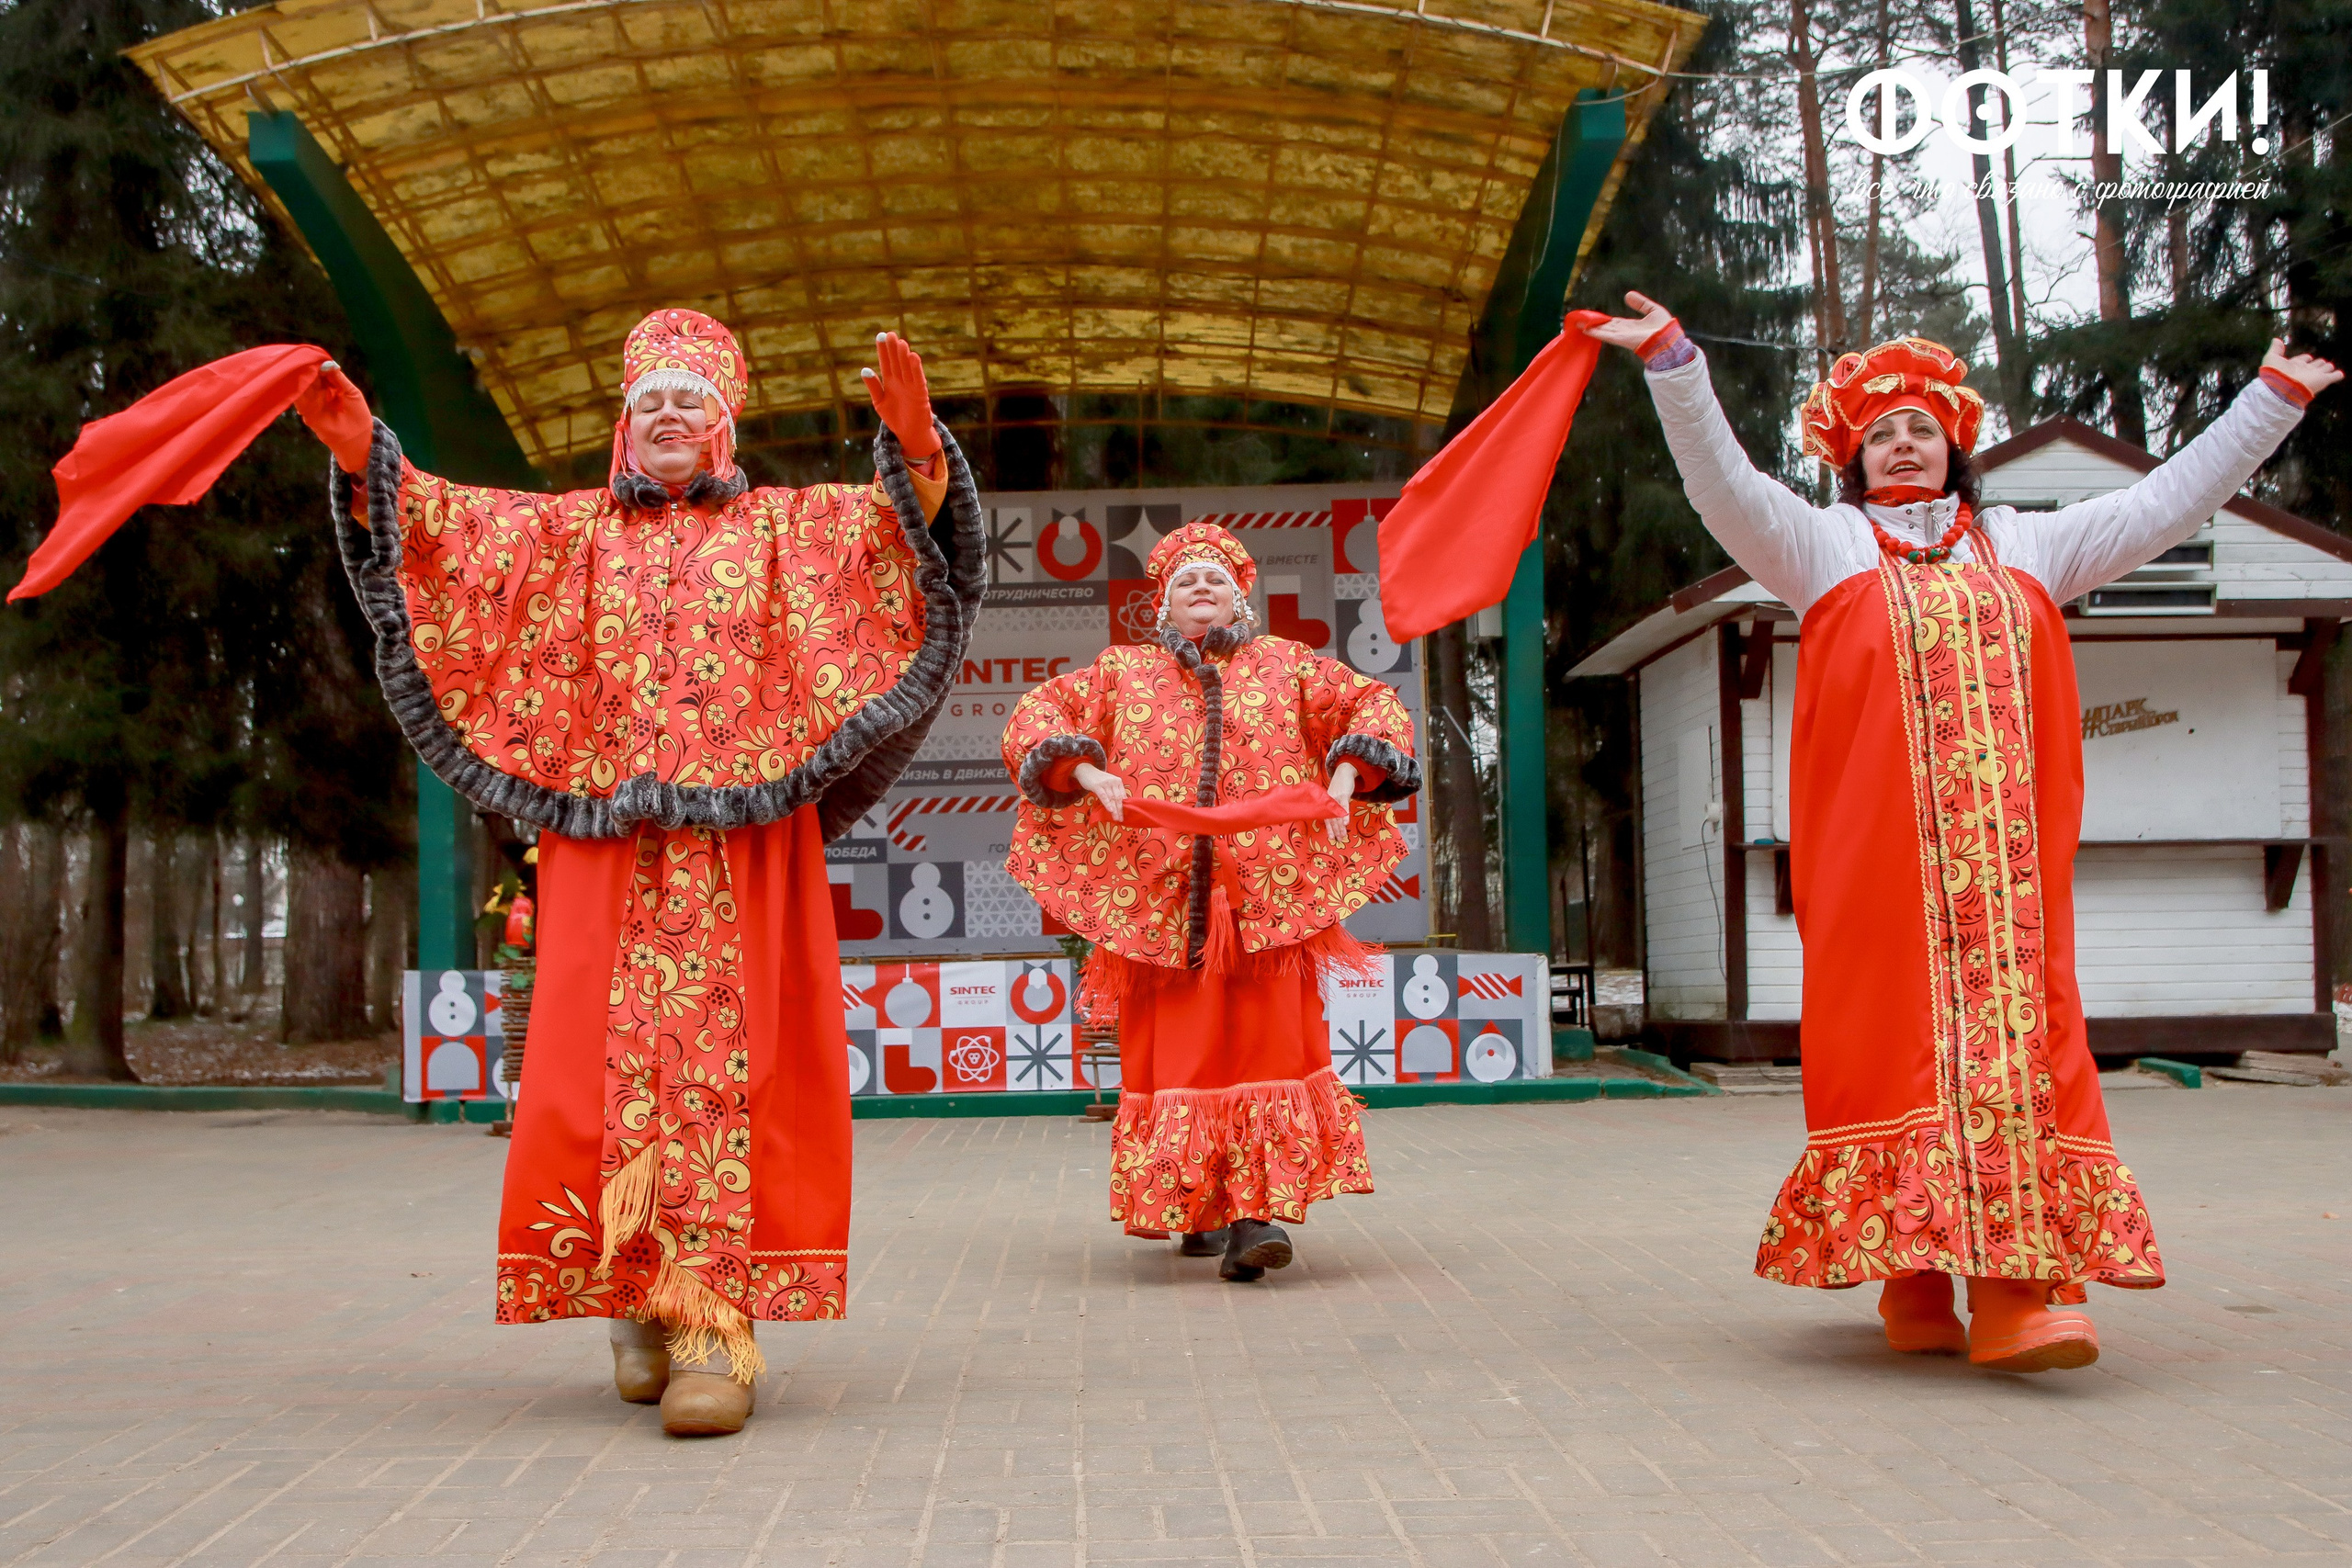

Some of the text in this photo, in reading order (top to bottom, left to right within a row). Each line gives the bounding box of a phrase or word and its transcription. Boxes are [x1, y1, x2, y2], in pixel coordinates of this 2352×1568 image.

[1266, 554, 1318, 566] ВМЕСТЕ
[982, 587, 1094, 602] ОТРУДНИЧЕСТВО
[956, 656, 1070, 684] NTEC
[950, 702, 1018, 716] GRO
[943, 769, 952, 780] В
[1339, 979, 1385, 988] SINTEC
[949, 986, 996, 995] SINTEC
